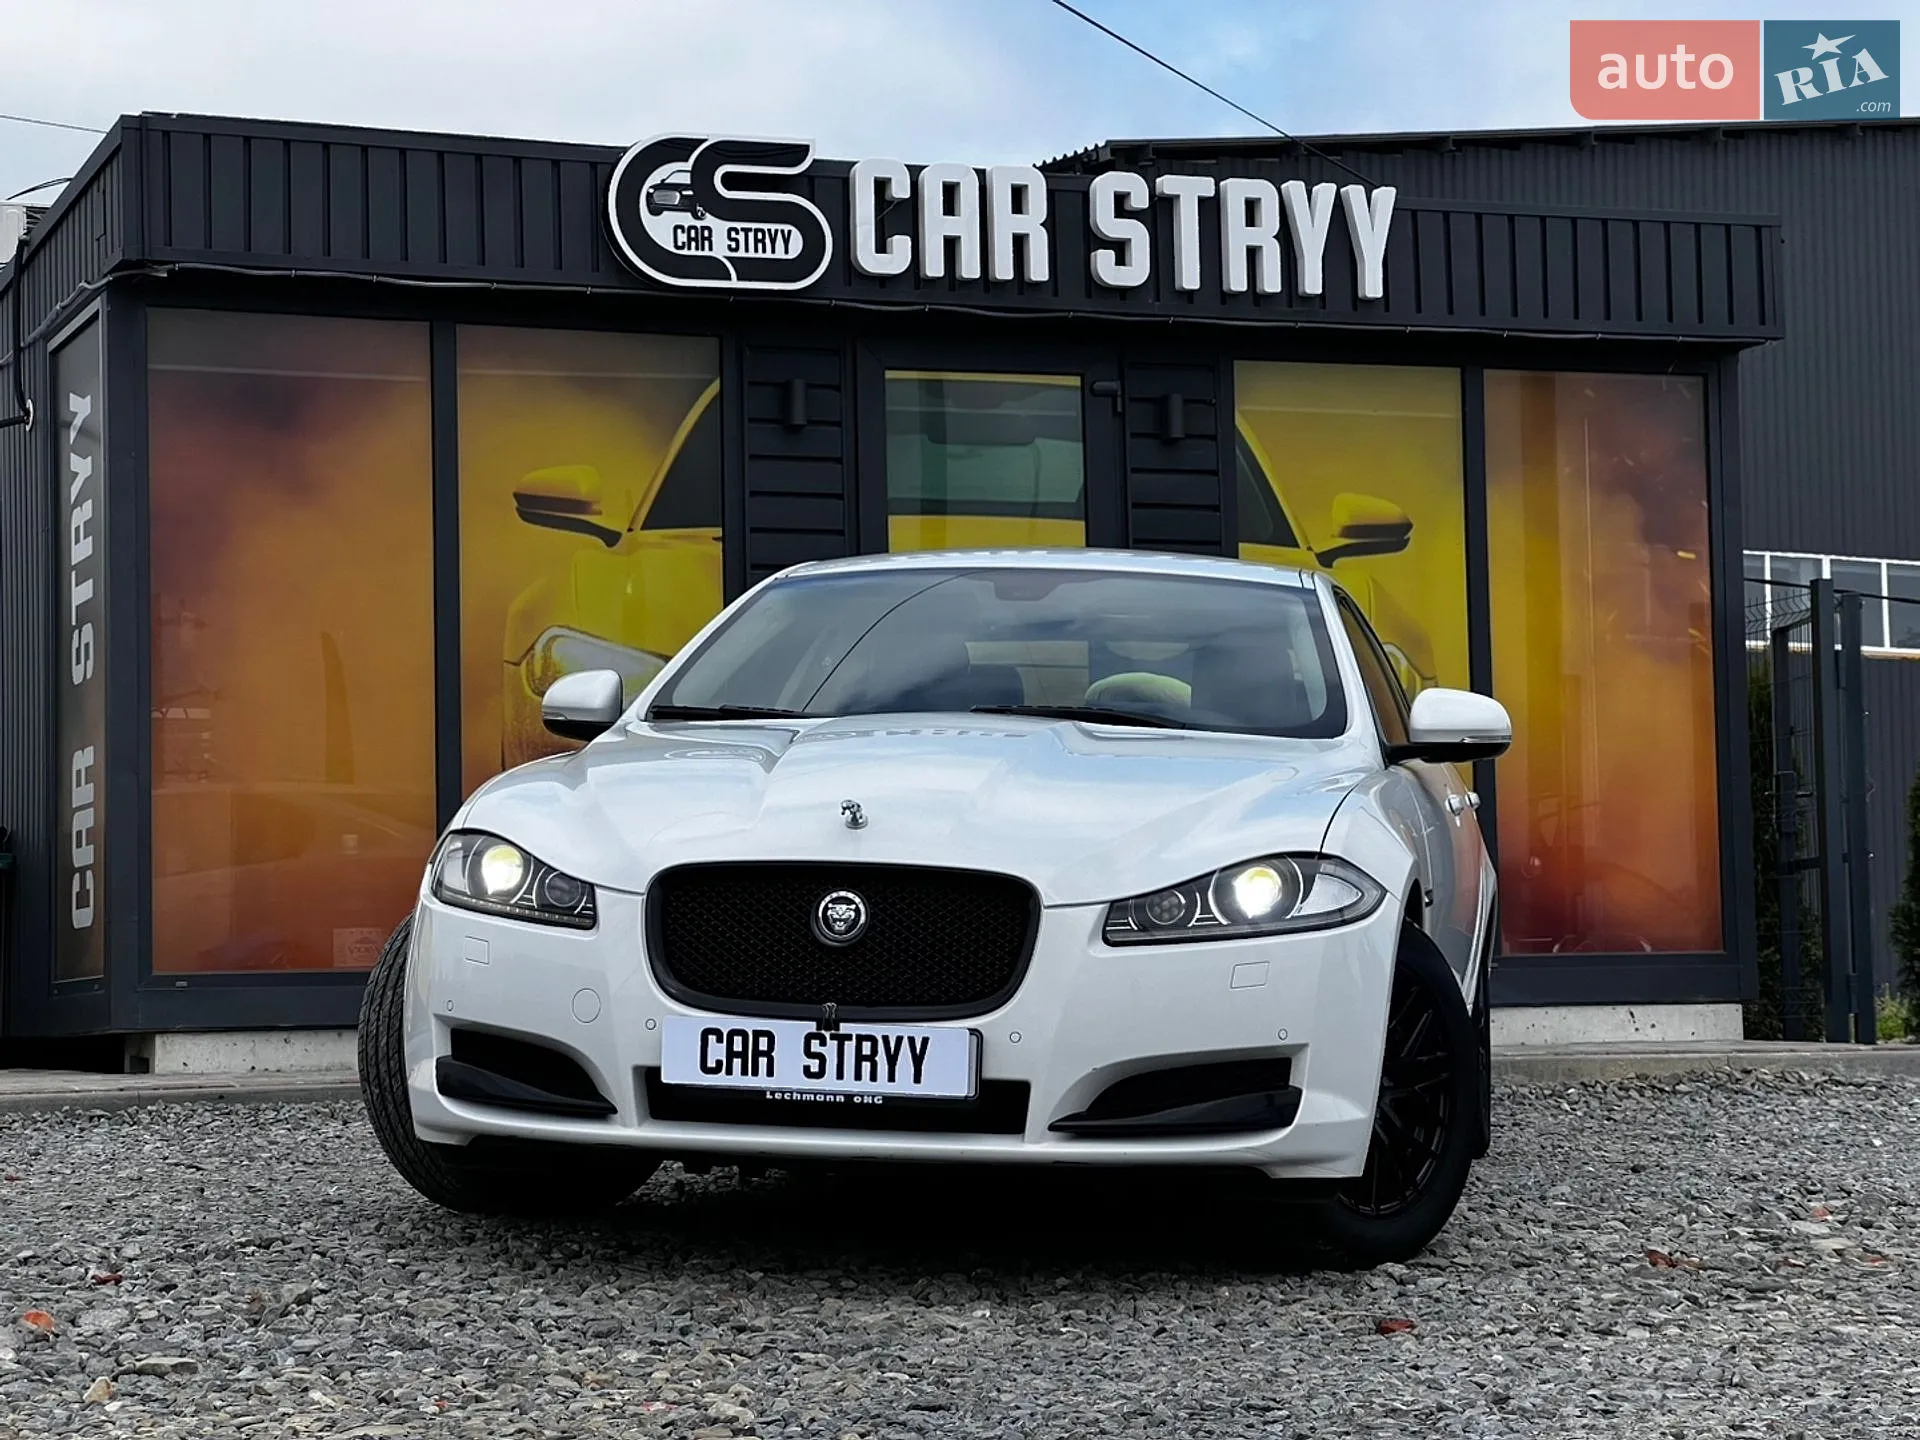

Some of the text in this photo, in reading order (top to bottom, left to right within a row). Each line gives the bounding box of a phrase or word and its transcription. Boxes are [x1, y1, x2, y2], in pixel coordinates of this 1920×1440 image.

[672, 225, 792, 255] CAR STRYY
[849, 158, 1397, 299] CAR STRYY
[69, 392, 94, 930] CAR STRYY
[700, 1027, 930, 1084] CAR STRYY
[765, 1090, 845, 1103] Lechmann
